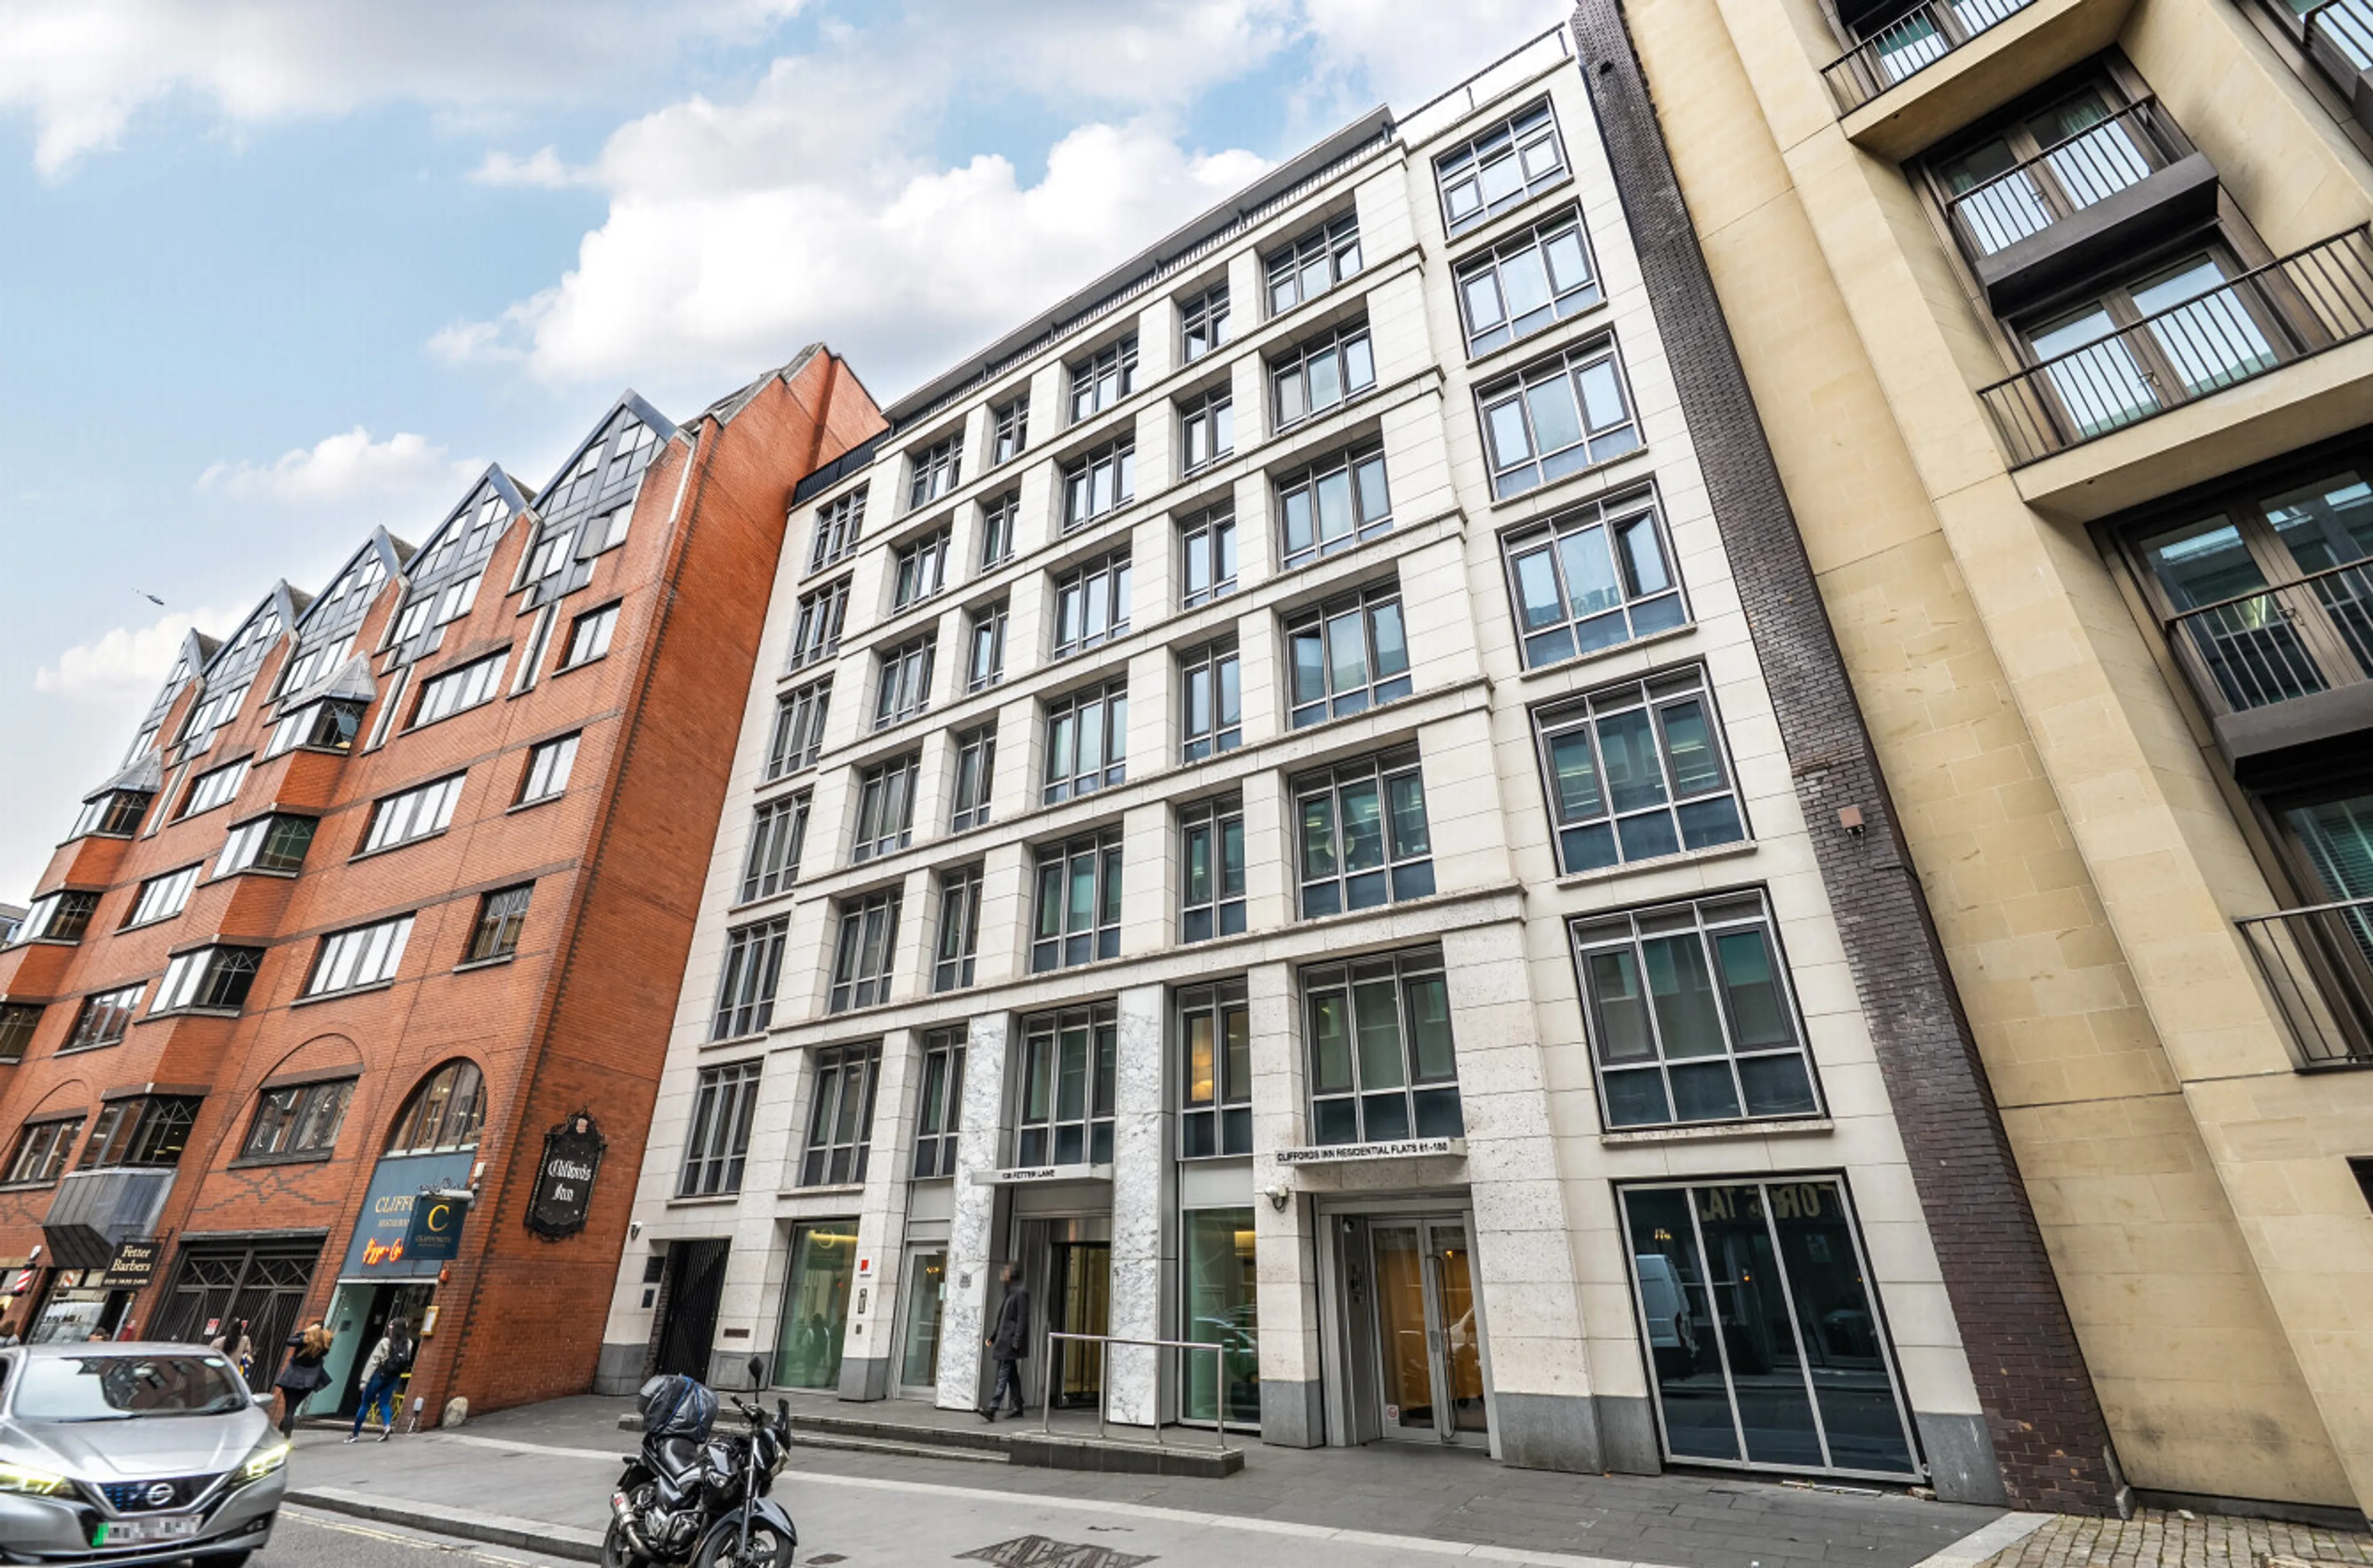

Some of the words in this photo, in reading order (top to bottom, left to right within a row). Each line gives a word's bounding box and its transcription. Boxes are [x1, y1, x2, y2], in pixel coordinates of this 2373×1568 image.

[1321, 1150, 1335, 1158] INN
[1336, 1146, 1390, 1158] RESIDENTIAL
[1391, 1143, 1417, 1154] FLATS
[1013, 1171, 1036, 1179] FETTER
[428, 1204, 450, 1233] C
[122, 1245, 152, 1258] Fetter
[111, 1258, 151, 1271] Barbers
